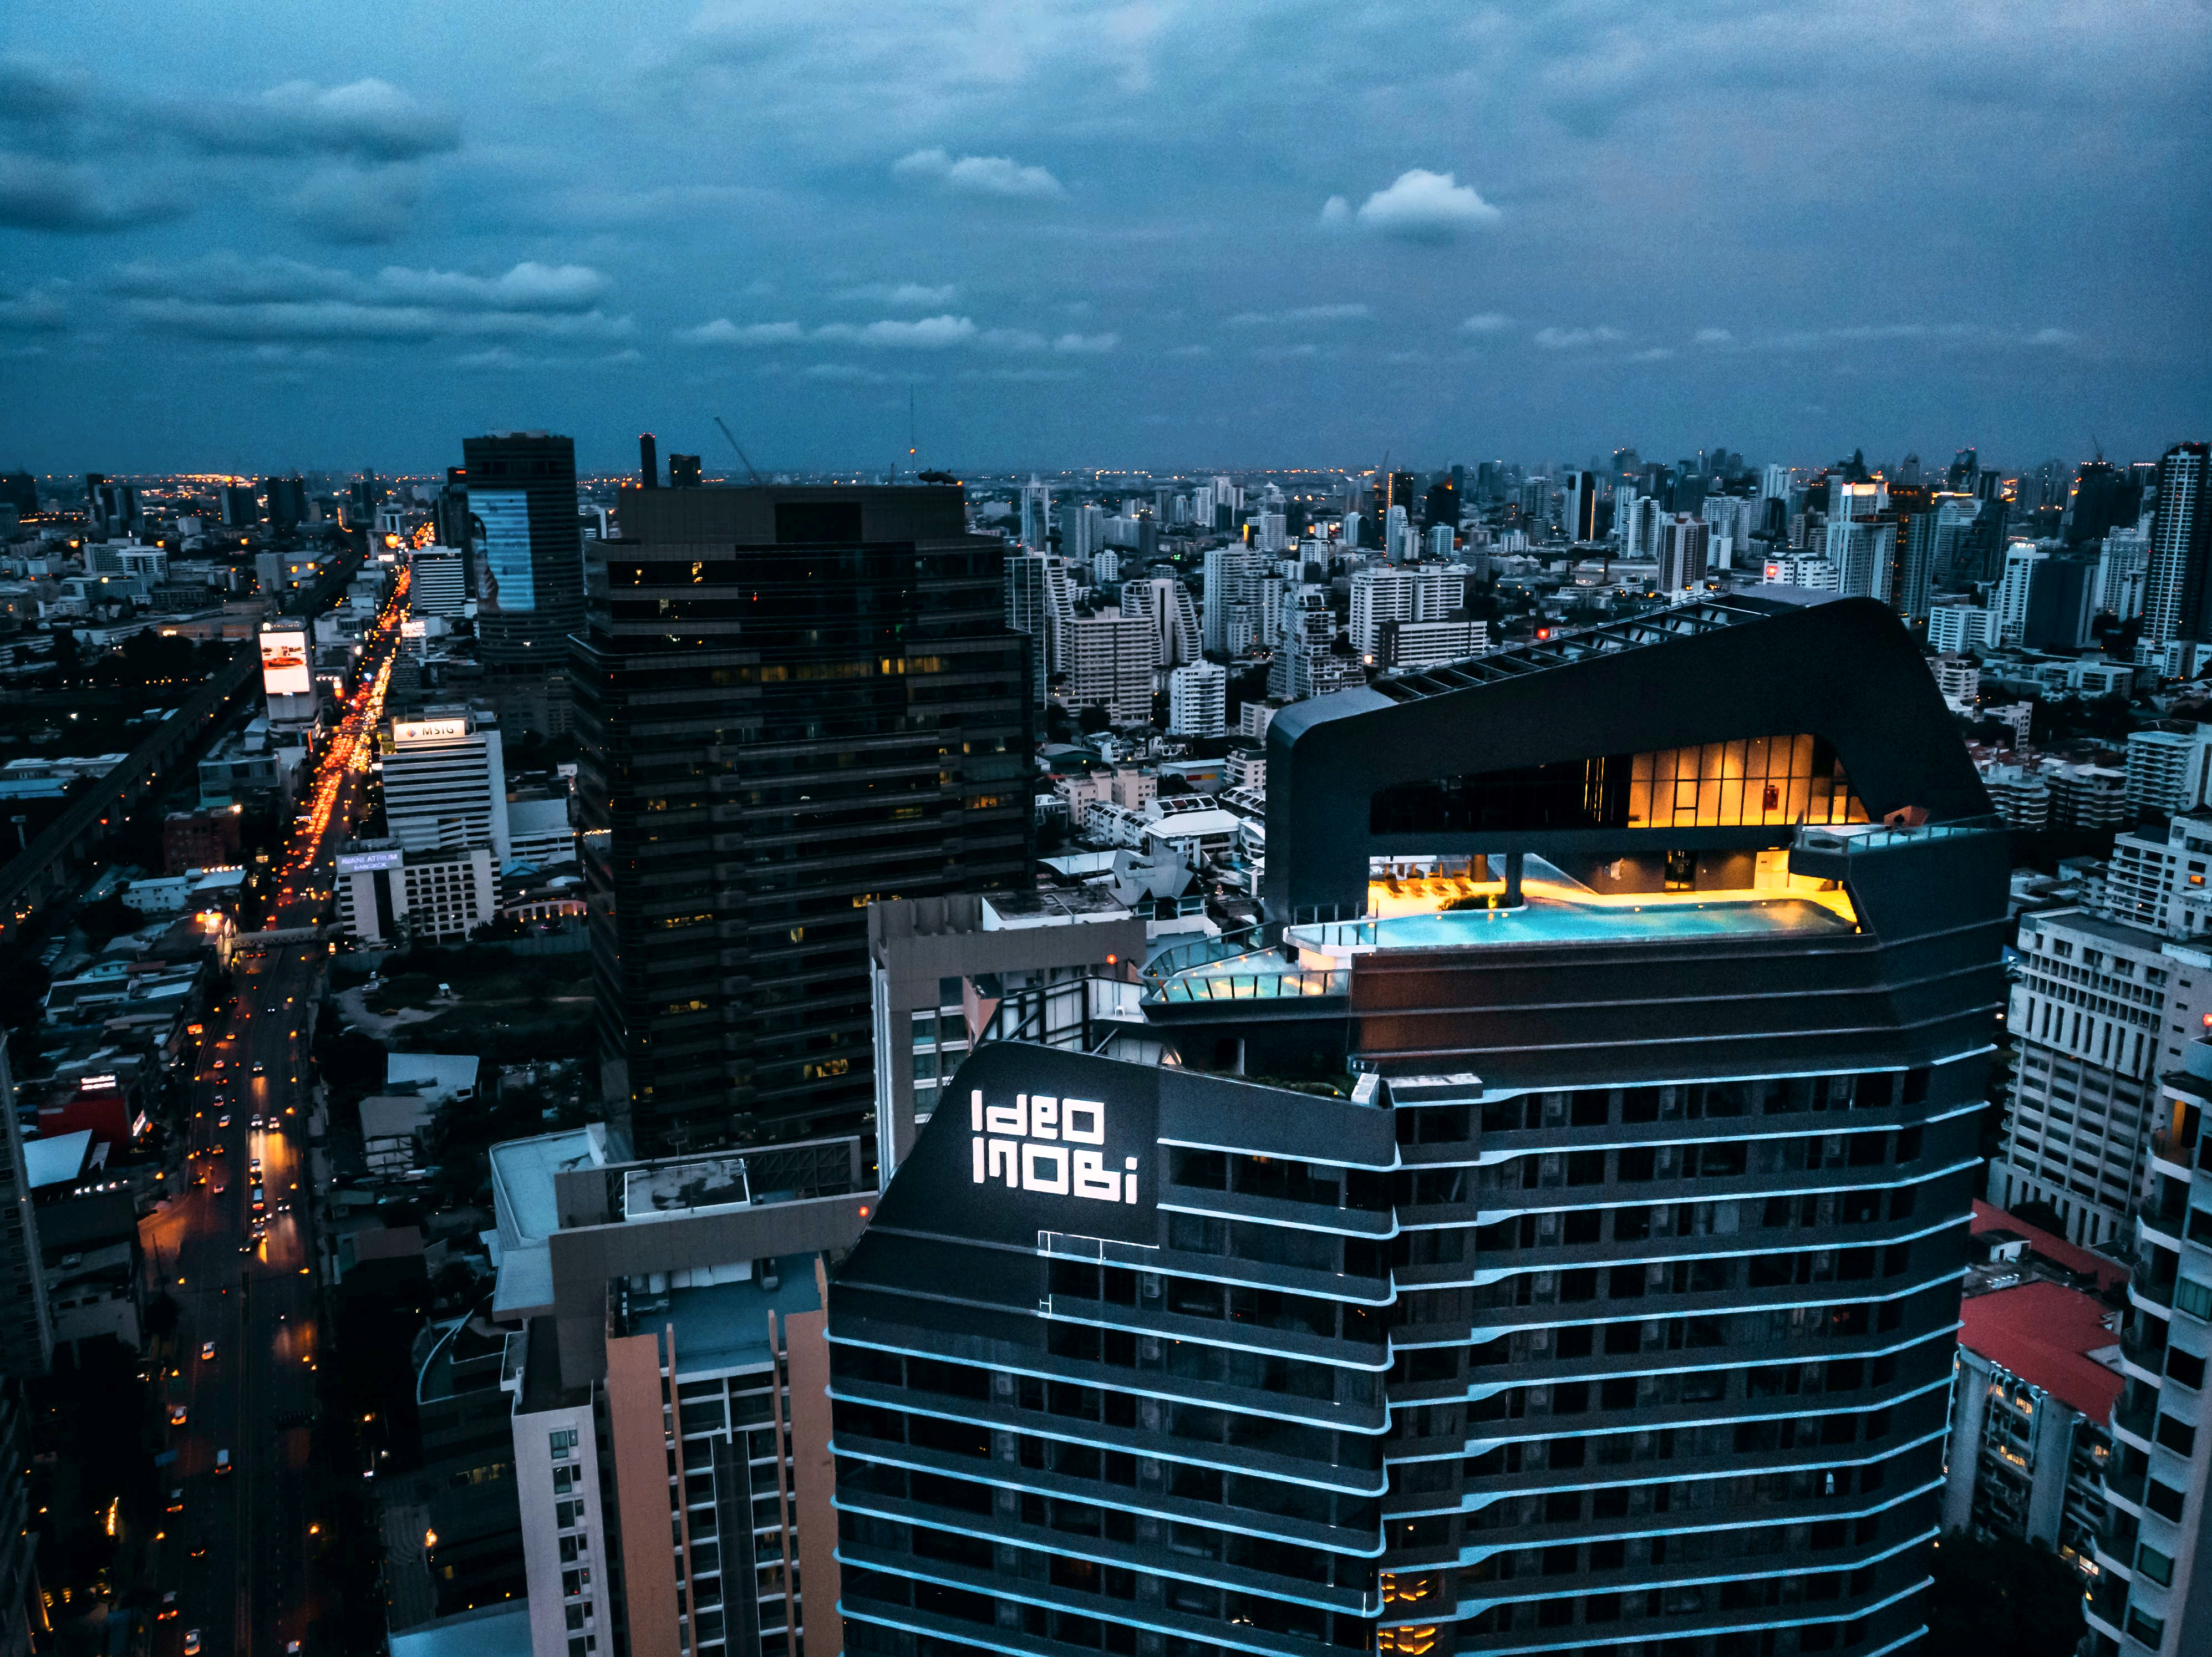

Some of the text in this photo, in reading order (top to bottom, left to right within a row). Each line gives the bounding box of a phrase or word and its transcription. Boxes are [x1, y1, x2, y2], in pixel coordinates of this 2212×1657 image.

[423, 726, 454, 735] MSIG
[342, 854, 397, 865] AVANI ATRIUM
[354, 862, 387, 871] BANGKOK
